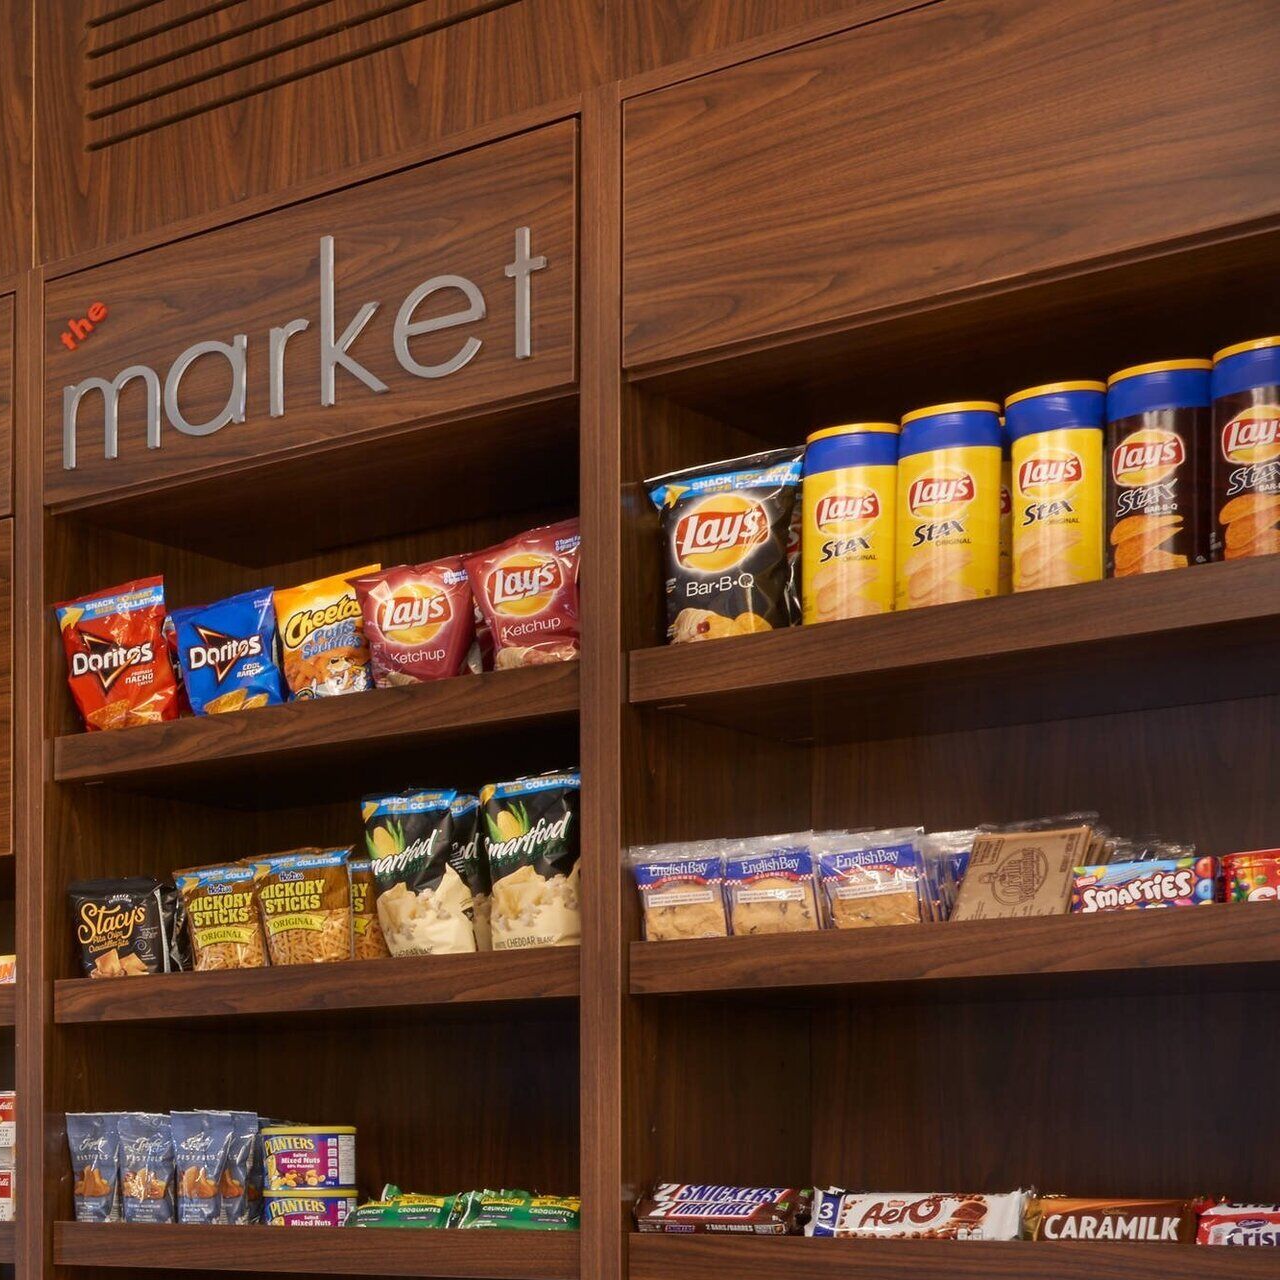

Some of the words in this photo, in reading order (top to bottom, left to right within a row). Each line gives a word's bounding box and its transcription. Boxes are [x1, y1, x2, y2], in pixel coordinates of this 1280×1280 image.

[60, 301, 109, 351] the
[62, 226, 548, 470] market
[692, 475, 732, 491] SNACK
[680, 508, 762, 556] Lay's
[493, 562, 557, 605] Lay's
[381, 595, 446, 632] Lay's
[502, 616, 562, 639] Ketchup
[72, 642, 154, 677] Doritos
[191, 635, 262, 670] Doritos
[390, 648, 446, 665] Ketchup
[260, 879, 326, 900] HICKORY
[190, 892, 253, 913] HICKORY
[265, 896, 321, 913] STICKS
[77, 902, 146, 945] Stacy's
[193, 910, 249, 927] STICKS
[272, 916, 315, 929] ORIGINAL
[265, 1136, 315, 1157] PLANTERS
[655, 1183, 680, 1201] 2
[269, 1198, 327, 1218] PLANTERS
[397, 1206, 441, 1214] CROQUANTES
[528, 1207, 575, 1218] CROQUANTES
[649, 1202, 672, 1216] 2
[674, 1203, 757, 1216] IRRITABLE
[819, 1202, 834, 1219] 3
[1043, 1214, 1181, 1241] CARAMILK
